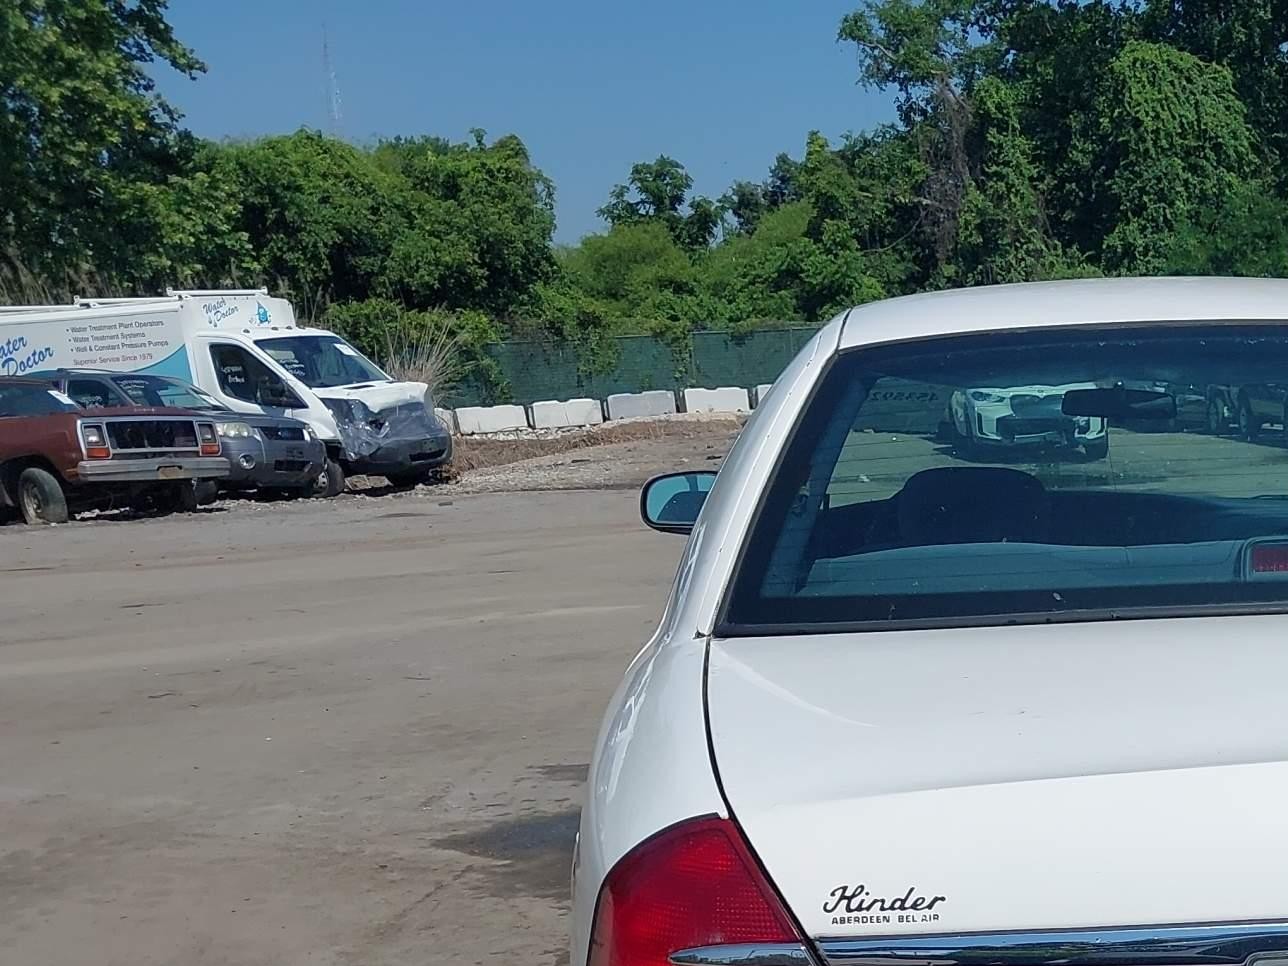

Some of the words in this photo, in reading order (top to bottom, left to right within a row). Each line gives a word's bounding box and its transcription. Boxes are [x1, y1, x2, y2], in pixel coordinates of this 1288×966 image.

[202, 296, 227, 314] Water
[213, 305, 239, 322] Doctor
[88, 323, 117, 332] Treatment
[118, 321, 133, 329] Plant
[134, 320, 164, 328] Operators
[90, 333, 119, 341] Treatment
[120, 332, 146, 340] Systems
[0, 336, 27, 359] ater
[94, 343, 120, 352] Constant
[121, 341, 146, 349] Pressure
[2, 347, 54, 376] Doctor
[823, 884, 946, 913] Hinder
[831, 915, 891, 925] ABERDEEN
[898, 914, 918, 924] BEL
[921, 914, 940, 923] AIR
